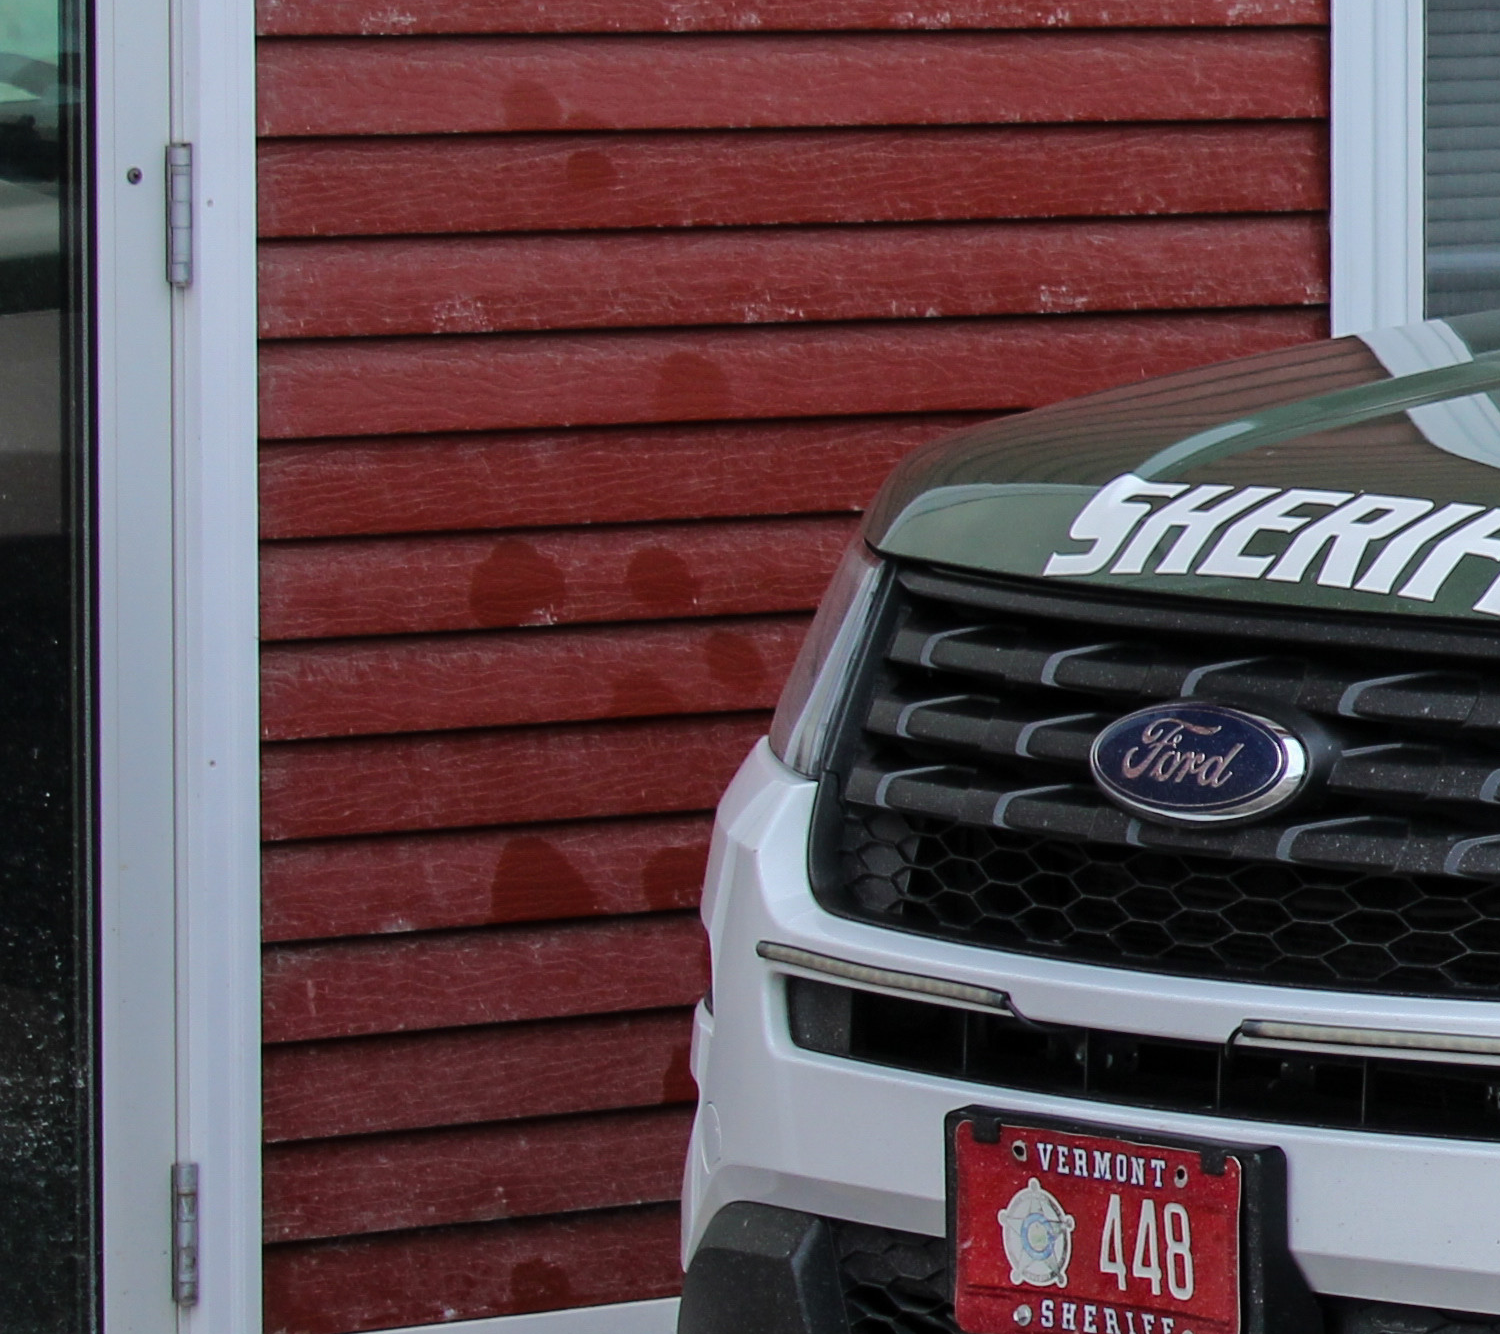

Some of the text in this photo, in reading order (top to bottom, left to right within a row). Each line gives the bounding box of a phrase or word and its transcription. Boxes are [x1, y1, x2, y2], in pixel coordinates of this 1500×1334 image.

[1121, 716, 1245, 790] Ford
[1036, 1142, 1167, 1189] VERMONT
[1099, 1193, 1195, 1301] 448
